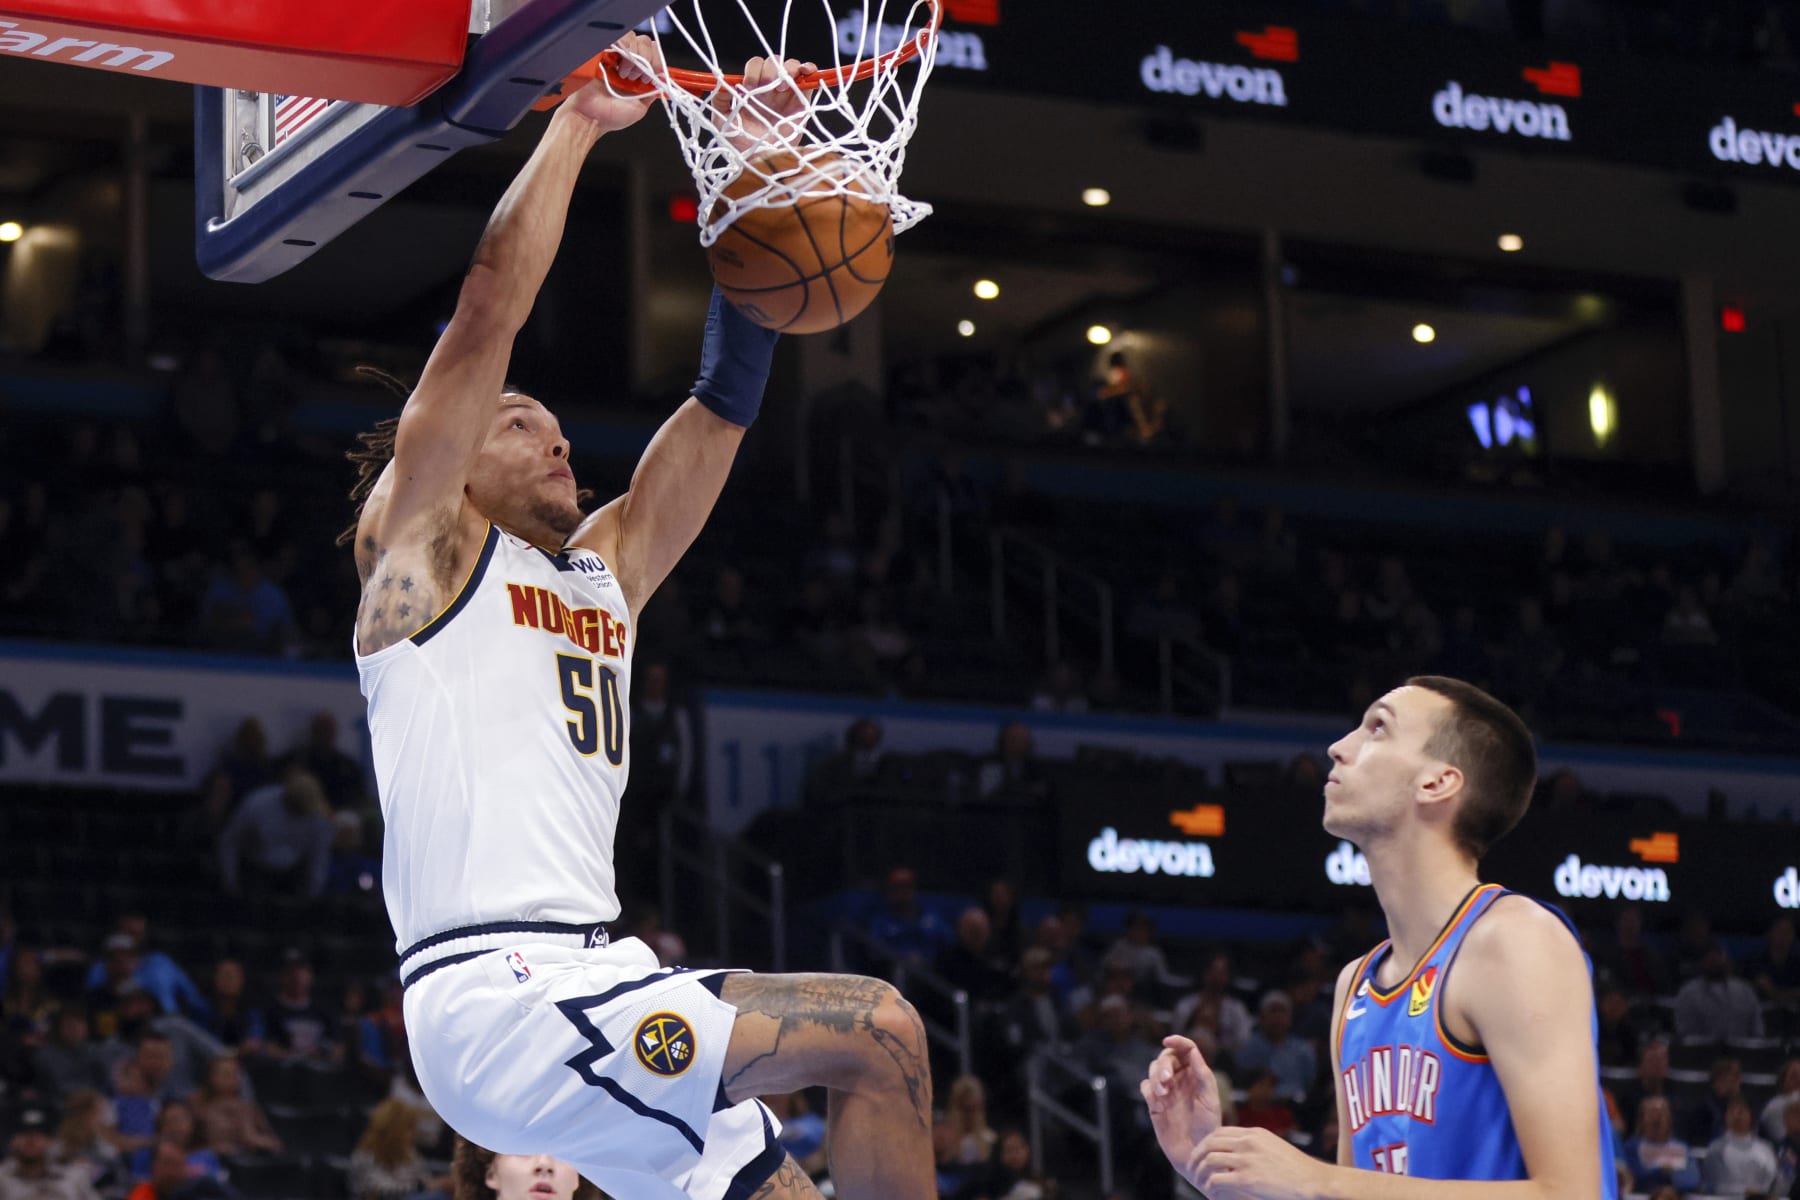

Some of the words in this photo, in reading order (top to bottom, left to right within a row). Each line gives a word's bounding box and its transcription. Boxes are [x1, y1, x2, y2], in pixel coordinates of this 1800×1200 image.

[0, 21, 175, 71] arm
[1140, 44, 1288, 106] devon
[1432, 80, 1572, 141] devon
[571, 556, 606, 574] WU
[506, 582, 626, 662] NUGGES
[555, 651, 624, 768] 50
[1087, 826, 1215, 877] devon
[1553, 853, 1671, 902] devon
